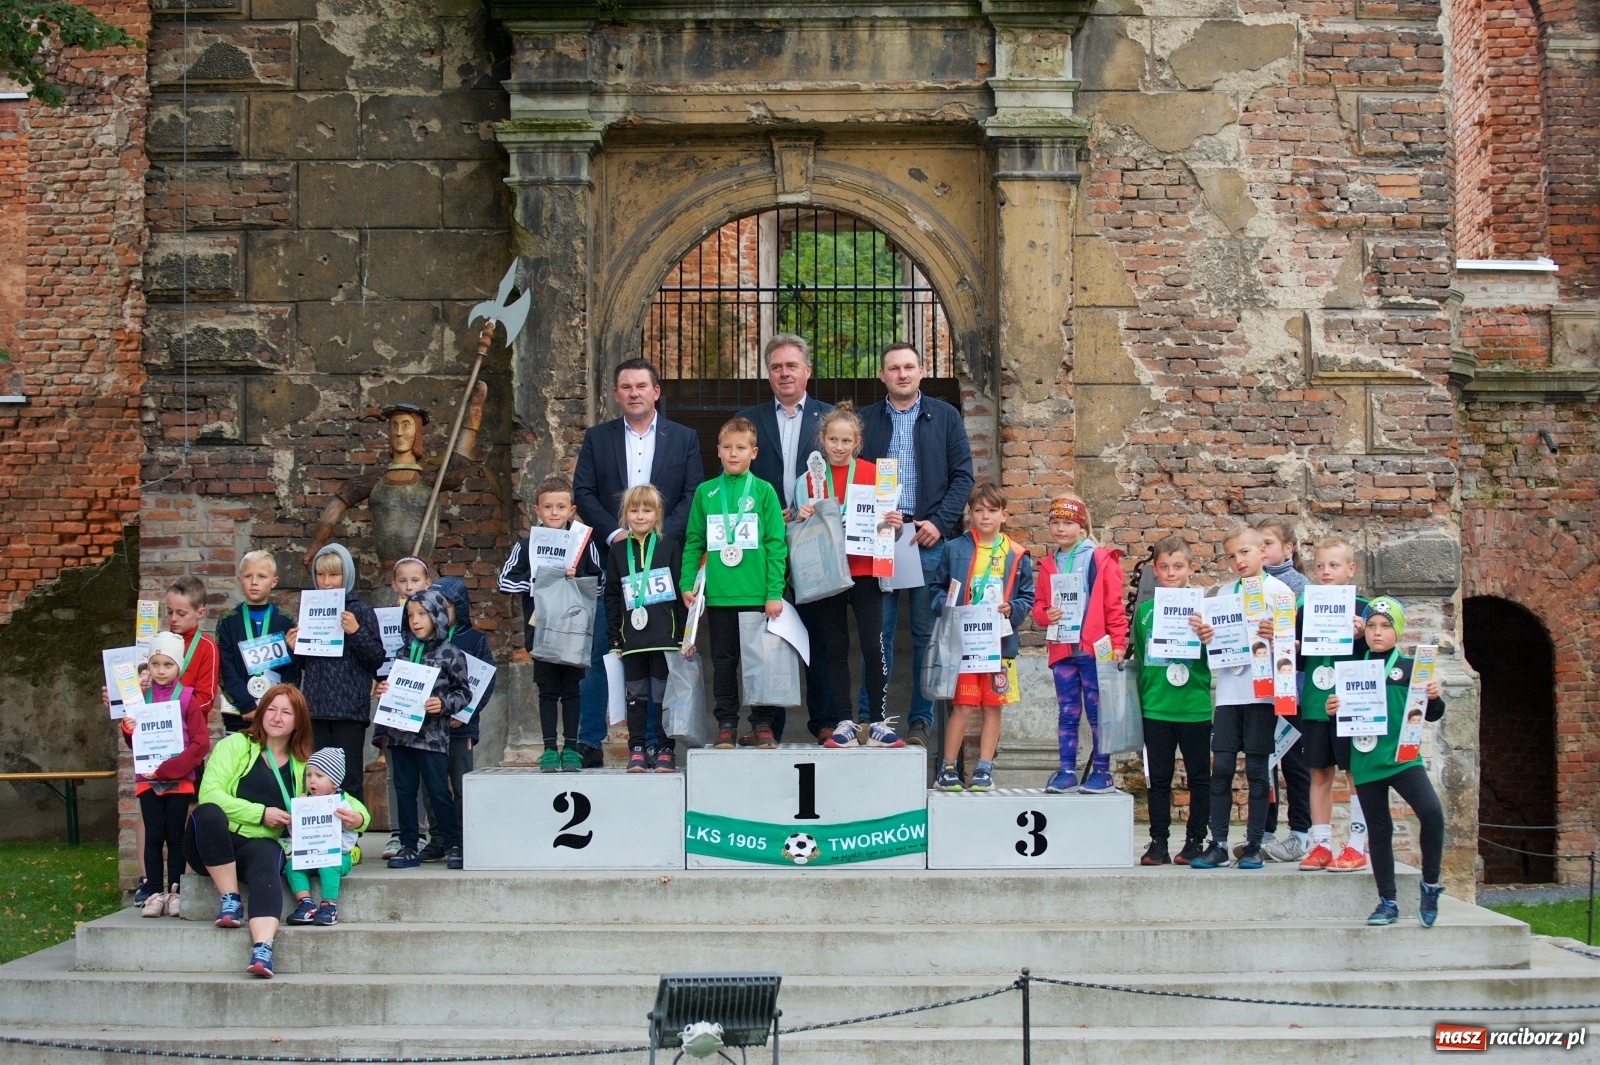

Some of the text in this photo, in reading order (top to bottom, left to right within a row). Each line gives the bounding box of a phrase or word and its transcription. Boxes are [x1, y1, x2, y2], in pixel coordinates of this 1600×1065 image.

[856, 503, 875, 513] DYPL
[715, 523, 750, 541] 34
[537, 545, 566, 557] DYPLOM
[1060, 592, 1077, 601] YPLOM
[309, 607, 338, 617] DYPLOM
[1163, 606, 1195, 616] DYPLOM
[1314, 604, 1346, 614] DYPLOM
[1212, 612, 1243, 625] DYPLOM
[383, 625, 402, 635] DYPL
[963, 622, 993, 632] DYPLOM
[248, 642, 284, 665] 320
[395, 677, 426, 691] DYPLOM
[1345, 680, 1377, 691] DYPLOM
[141, 719, 173, 731] DYPLOM
[794, 762, 820, 819] 1
[301, 814, 333, 826] DYPLOM
[552, 791, 593, 849] 2
[686, 823, 926, 851] LKS 1905 TWORKÓW
[1015, 810, 1048, 857] 3
